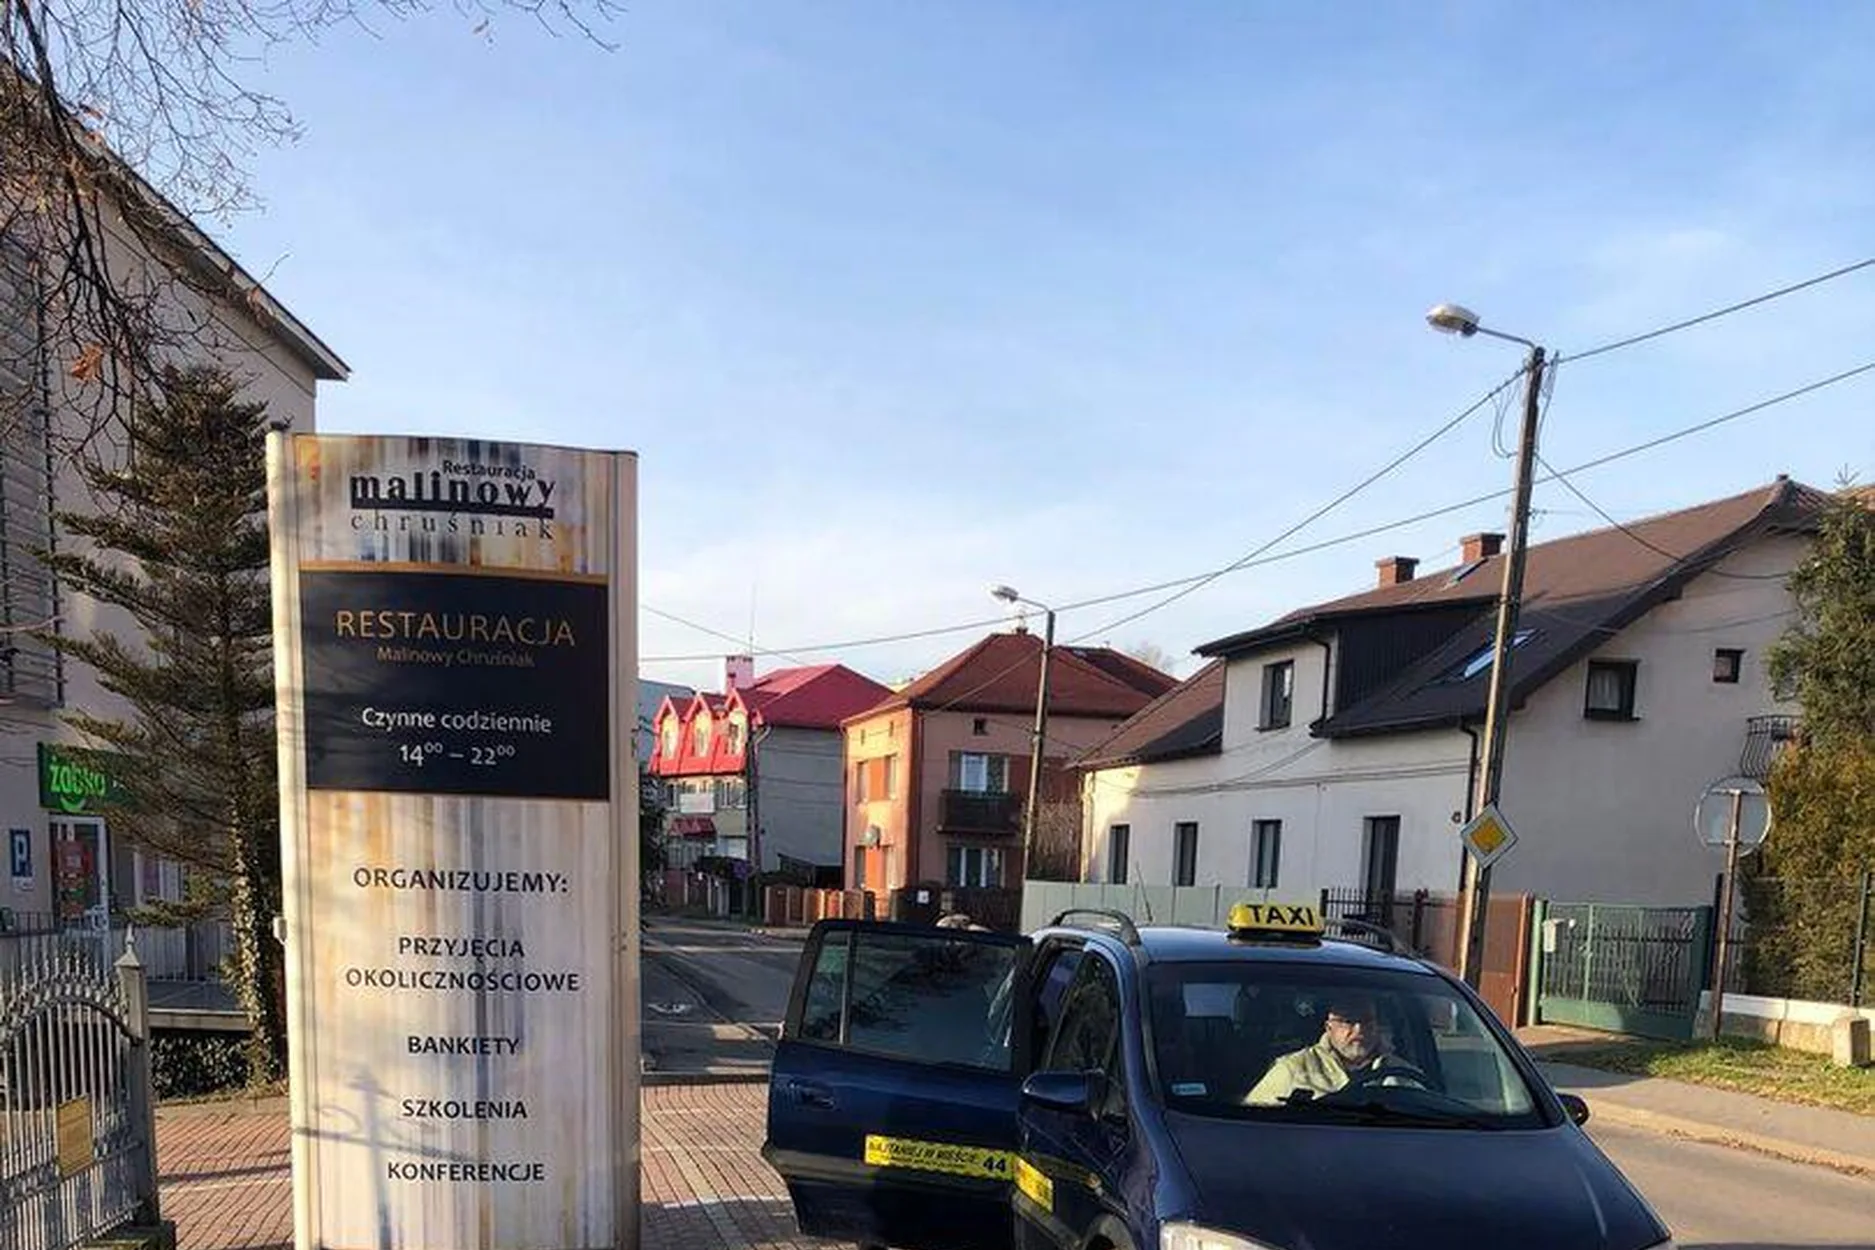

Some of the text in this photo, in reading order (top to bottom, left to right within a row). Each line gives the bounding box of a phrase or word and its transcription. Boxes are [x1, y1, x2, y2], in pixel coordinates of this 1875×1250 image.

[443, 460, 536, 482] Restauracja
[351, 470, 556, 508] malinowy
[351, 509, 554, 540] chruśniak
[336, 610, 576, 646] RESTAURACJA
[376, 647, 452, 667] Malinowy
[361, 707, 552, 733] Czynne codziennie
[353, 867, 568, 893] ORGANIZUJEMY:
[1246, 904, 1315, 926] TAXI
[399, 936, 525, 964] PRZYJĘCIA
[346, 968, 580, 992] OKOLICZNOŚCIOWE
[407, 1036, 520, 1055] BANKIETY
[402, 1099, 528, 1119] SZKOLENIA
[387, 1162, 545, 1182] KONFERENCJE
[983, 1156, 1007, 1173] 44
